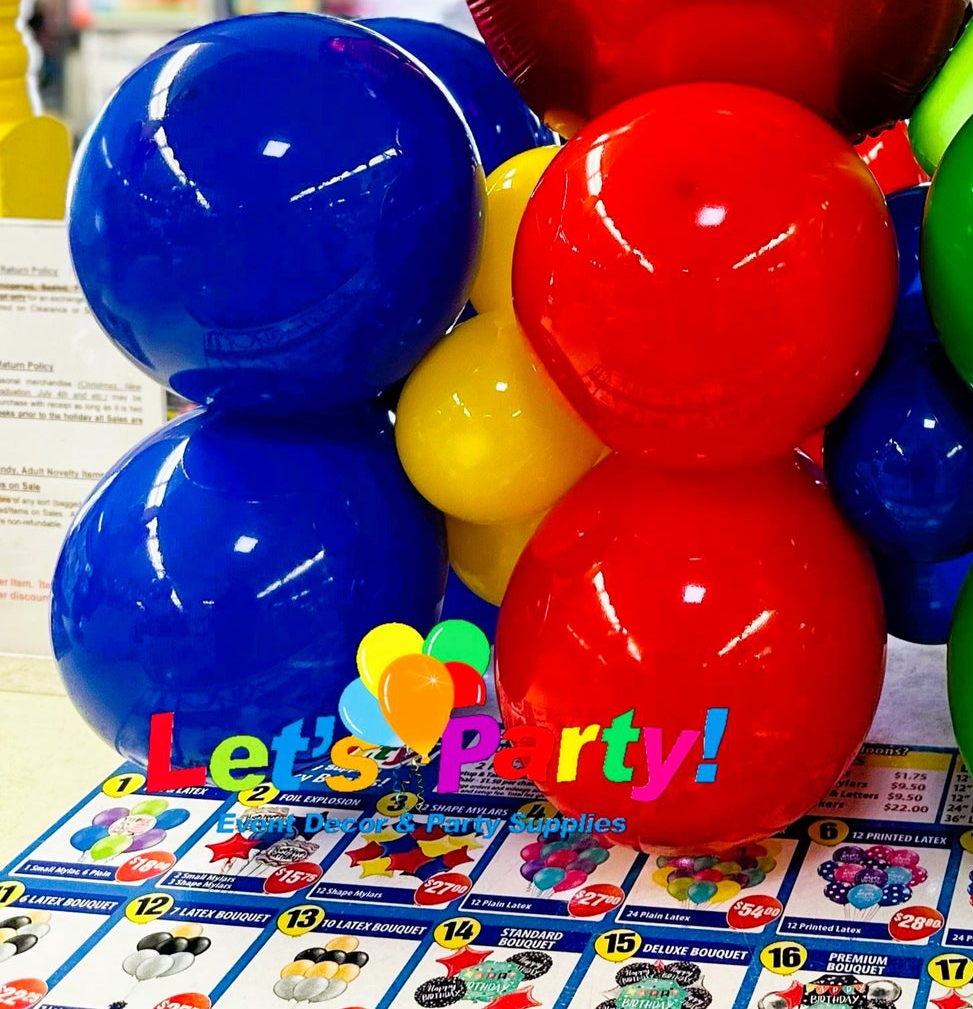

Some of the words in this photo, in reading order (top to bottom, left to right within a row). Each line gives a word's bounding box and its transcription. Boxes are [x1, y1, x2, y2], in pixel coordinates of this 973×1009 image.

[894, 772, 928, 781] $1.75
[116, 776, 133, 792] 1
[891, 782, 926, 791] $9.50
[246, 786, 265, 802] 2
[279, 794, 304, 802] FOIL
[304, 795, 361, 806] EXPLOSION
[840, 791, 879, 800] Letters
[887, 793, 923, 802] $9.50
[386, 794, 409, 811] 3
[884, 803, 929, 813] $22.00
[430, 804, 465, 813] SHAPE
[467, 806, 509, 816] MYLARS
[866, 832, 913, 842] PRINTED
[914, 835, 948, 845] LATEX
[31, 865, 55, 875] Small
[88, 869, 112, 878] Plain
[175, 878, 202, 890] Shape
[203, 881, 232, 890] Mylars
[207, 874, 236, 883] Mylars
[326, 888, 352, 897] Shape
[354, 890, 383, 899] Mylars
[19, 895, 28, 903] 6
[29, 895, 64, 907] LATEX
[64, 896, 119, 910] BOUQUET
[134, 896, 169, 915] 12
[470, 899, 481, 907] 12
[482, 900, 505, 908] Plain
[506, 902, 533, 910] Latex
[179, 907, 215, 919] LATEX
[215, 908, 272, 923] BOUQUET
[286, 908, 318, 928] 13
[626, 910, 638, 918] 24
[640, 912, 662, 920] Plain
[665, 913, 691, 922] Latex
[323, 919, 334, 928] 10
[335, 920, 372, 932] LATEX
[368, 922, 428, 936] BOUQUET
[443, 921, 474, 942] 14
[799, 923, 833, 932] Printed
[835, 925, 862, 934] Latex
[501, 928, 563, 941] STANDARD
[952, 934, 964, 942] 24
[498, 937, 556, 950] BOUQUET
[604, 932, 637, 953] 15
[642, 943, 687, 956] DELUXE
[690, 946, 749, 961] BOUQUET
[767, 946, 802, 968] 16
[828, 952, 888, 965] PREMIUM
[826, 962, 886, 975] BOUQUET
[934, 958, 968, 980] 17
